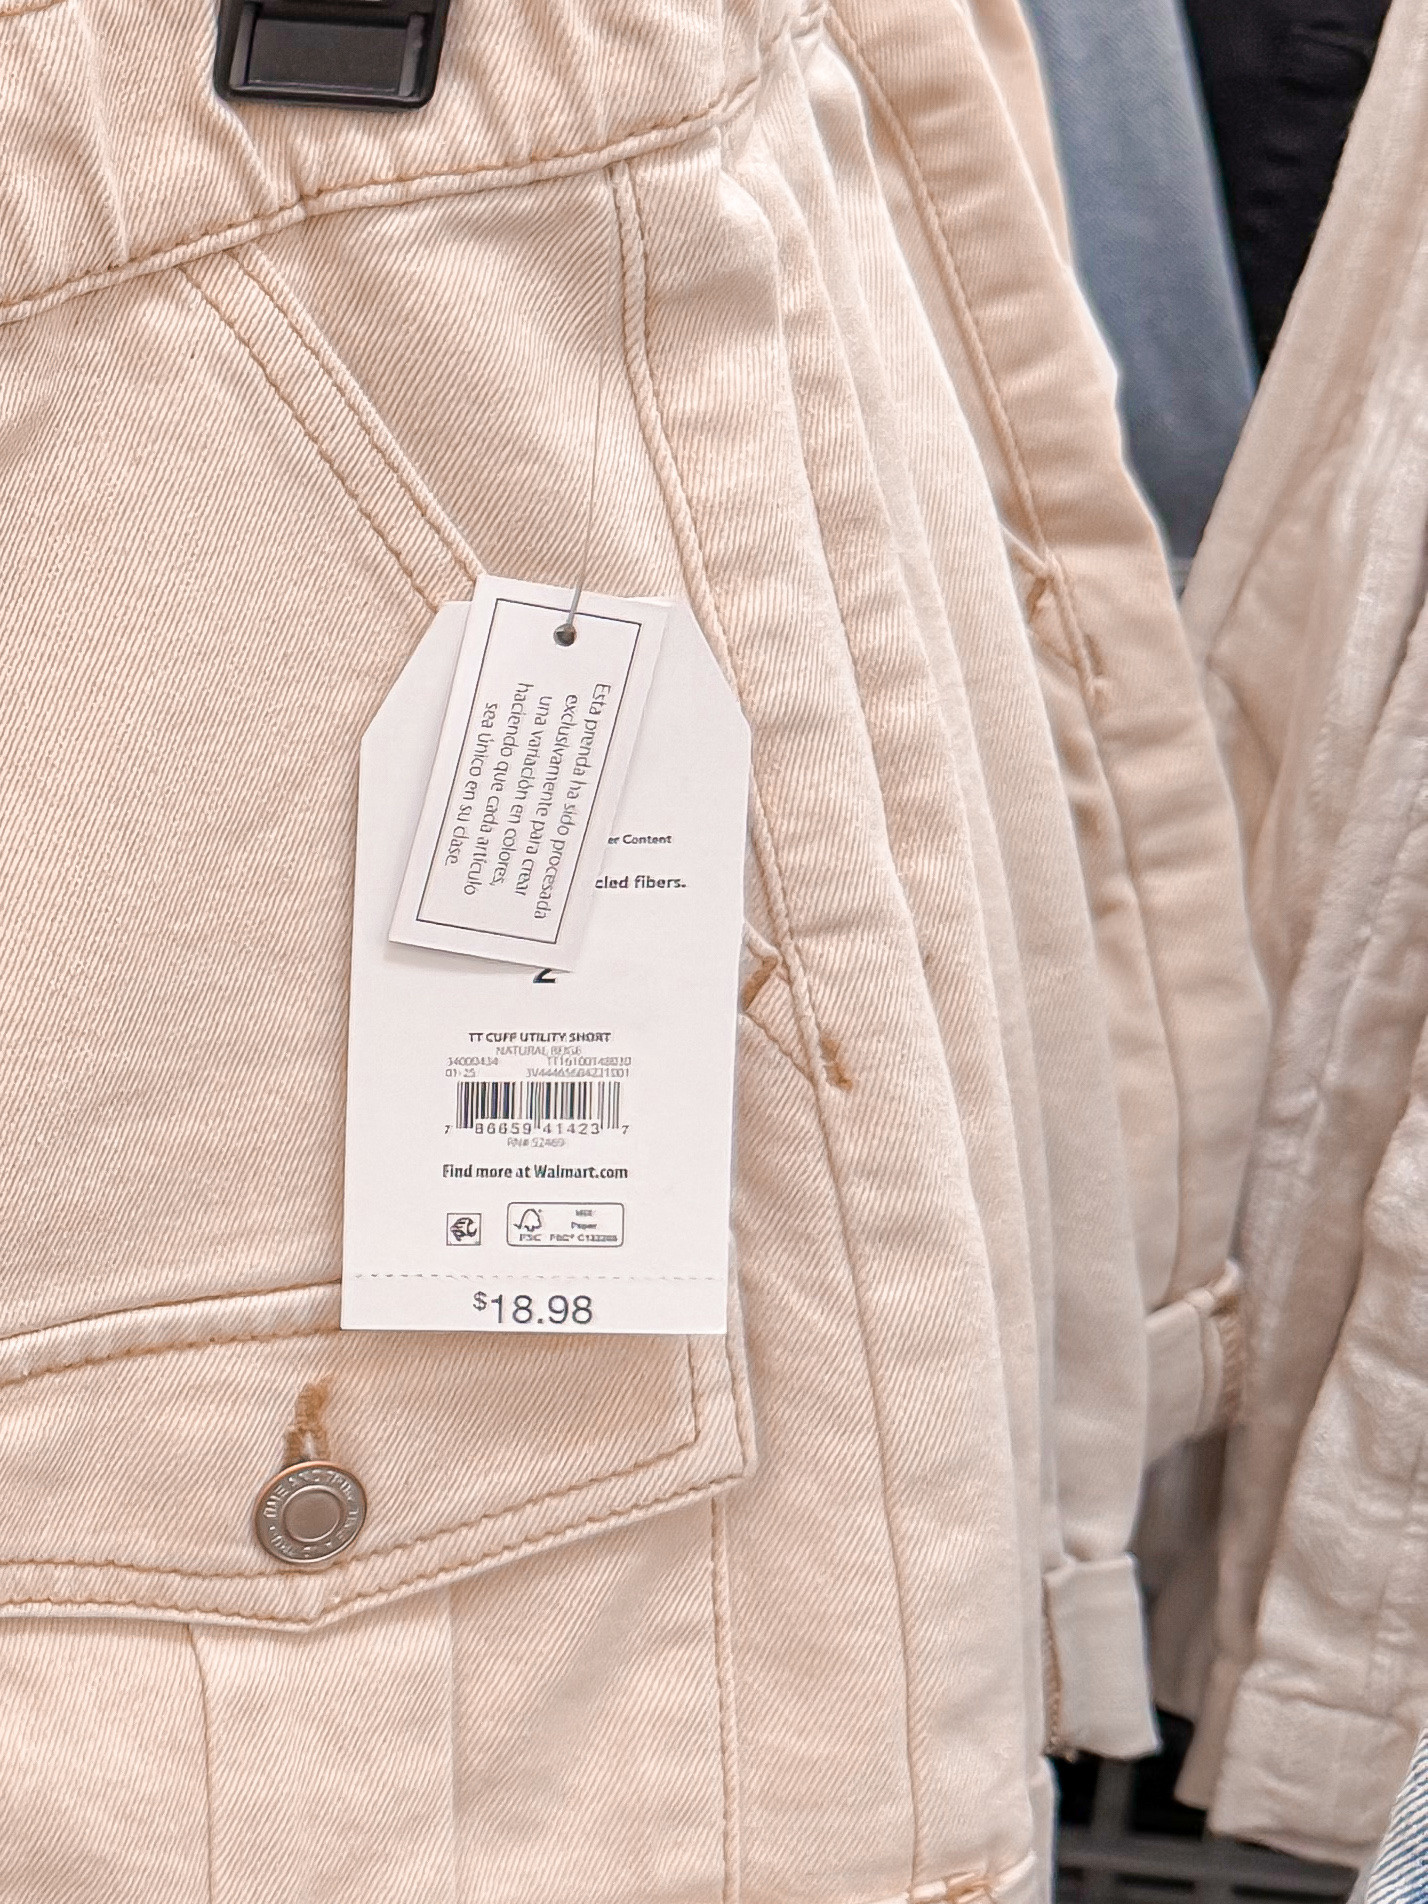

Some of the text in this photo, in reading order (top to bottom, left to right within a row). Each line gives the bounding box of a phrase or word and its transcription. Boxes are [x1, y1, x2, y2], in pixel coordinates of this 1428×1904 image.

[481, 702, 499, 729] sea
[500, 682, 535, 758] haciendo
[534, 695, 553, 727] una
[468, 731, 496, 778] único
[462, 780, 479, 801] en
[489, 760, 510, 794] que
[514, 694, 578, 897] exclusivamente para crear
[534, 682, 612, 920] Esta prenda ha sido procesada
[456, 803, 473, 823] su
[480, 795, 500, 834] cada
[509, 803, 524, 825] en
[622, 834, 673, 845] Content
[489, 826, 517, 887] colores,
[634, 874, 687, 889] fibers.
[468, 1032, 612, 1043] TT CUFF UTILITY SHORT
[495, 1045, 548, 1057] NATURAL
[475, 1122, 533, 1135] 86659
[542, 1122, 601, 1135] 41423
[443, 1164, 629, 1179] Find more at Walmart.com
[472, 1290, 594, 1325] $18.98
